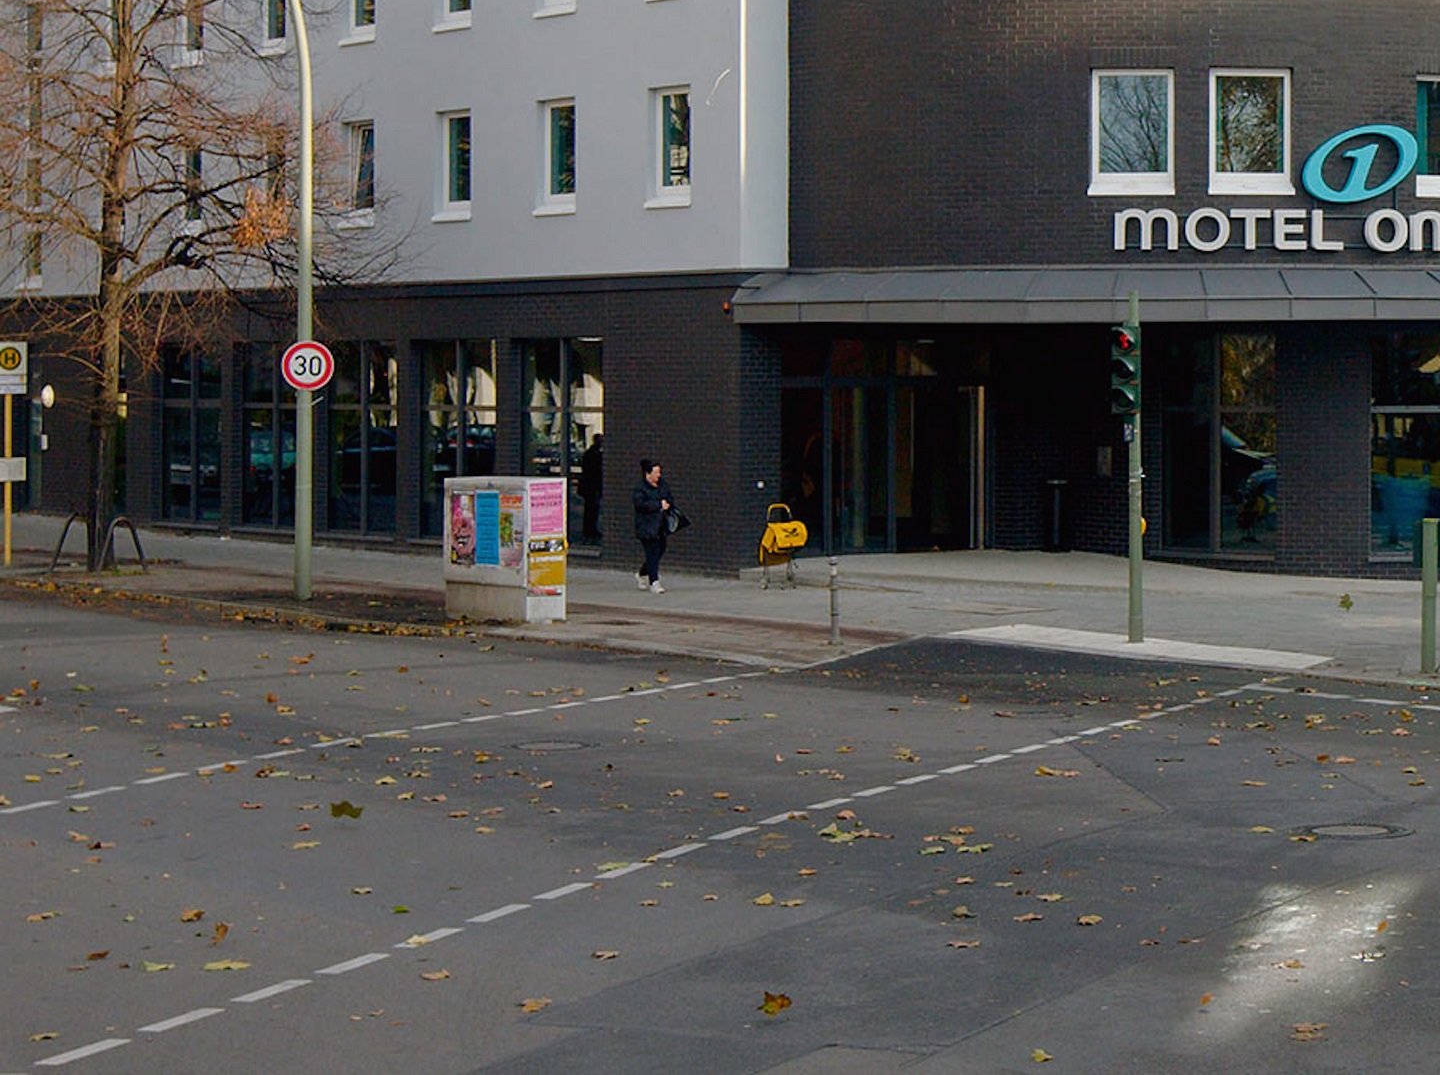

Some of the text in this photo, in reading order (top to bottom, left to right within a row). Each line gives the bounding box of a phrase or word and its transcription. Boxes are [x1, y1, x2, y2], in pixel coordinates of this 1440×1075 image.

[1114, 208, 1344, 252] MOTEL
[4, 352, 16, 365] H
[294, 355, 322, 376] 30
